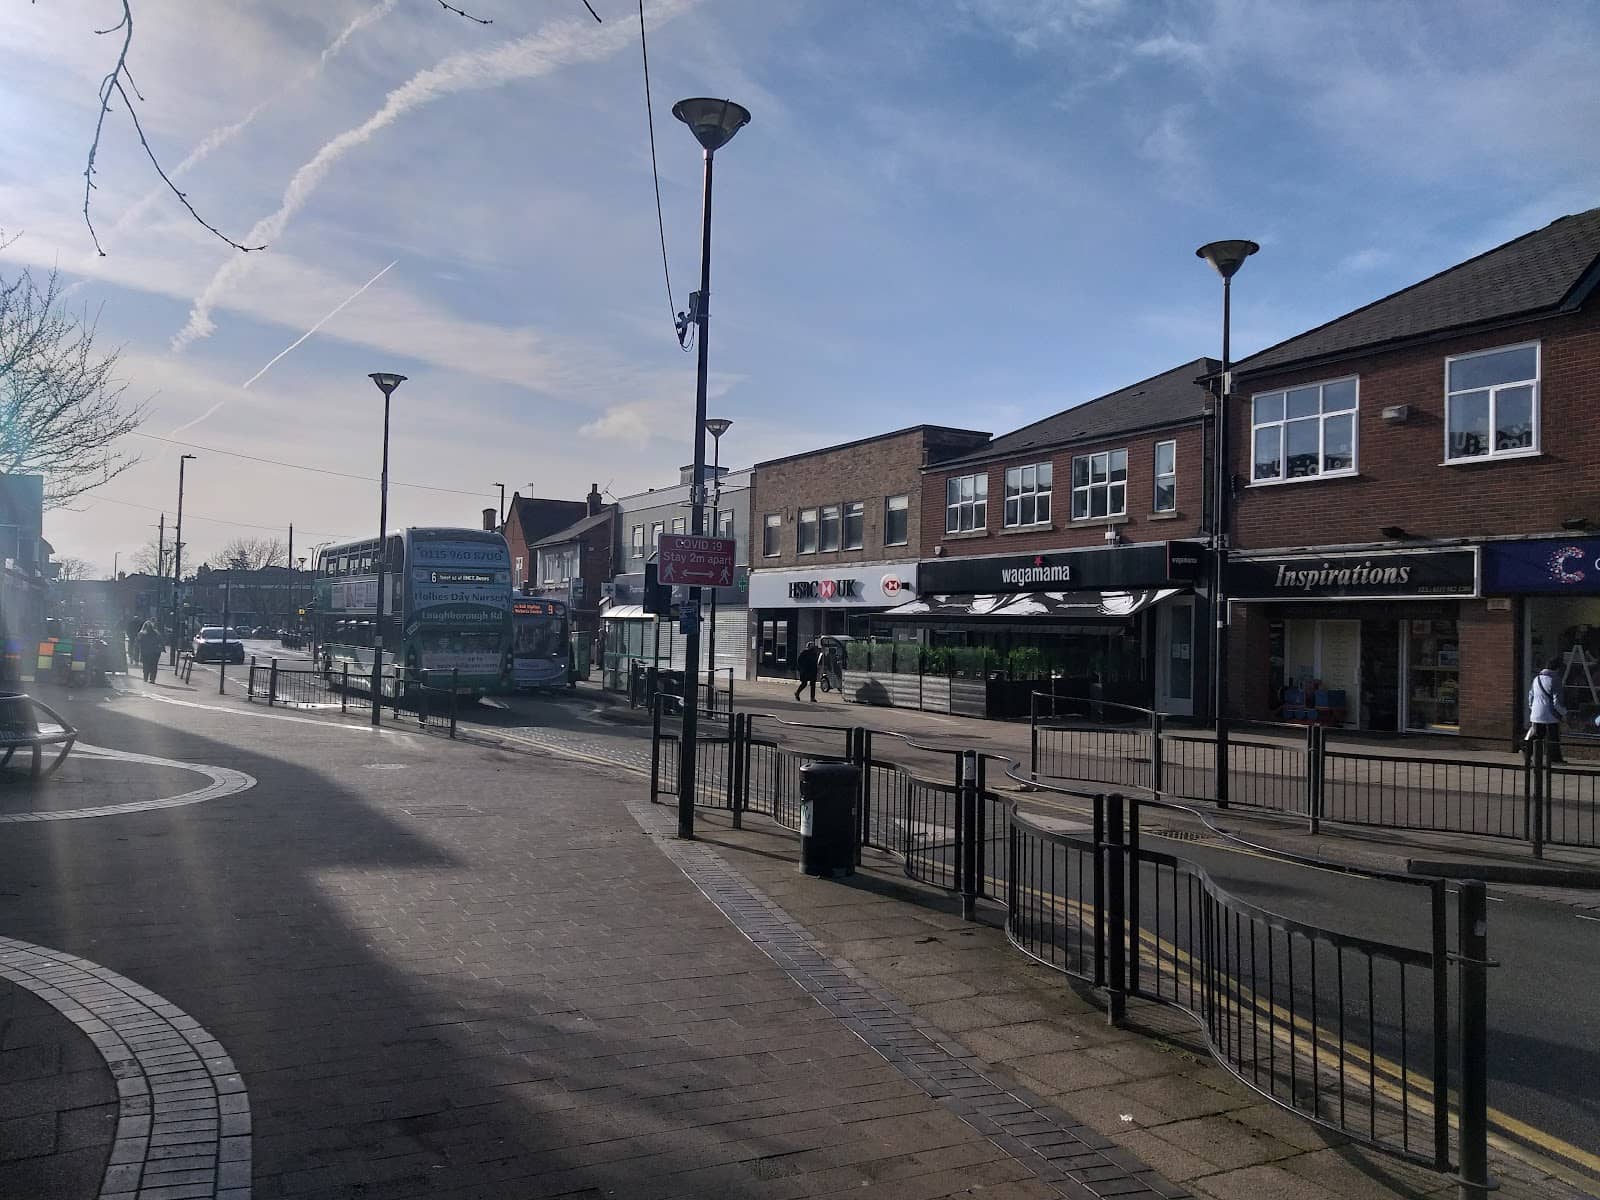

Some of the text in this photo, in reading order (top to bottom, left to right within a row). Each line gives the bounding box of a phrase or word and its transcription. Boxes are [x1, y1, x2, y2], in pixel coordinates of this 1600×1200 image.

[675, 538, 709, 550] COVID
[663, 551, 732, 567] Stay 2m apart
[431, 572, 437, 583] 6
[1001, 565, 1070, 586] wagamama
[1274, 561, 1411, 591] Inspirations
[788, 579, 856, 599] HSBC UK
[414, 591, 511, 604] Hollies Day Nursery
[547, 604, 554, 615] 9
[422, 611, 503, 622] Loughborough Rd
